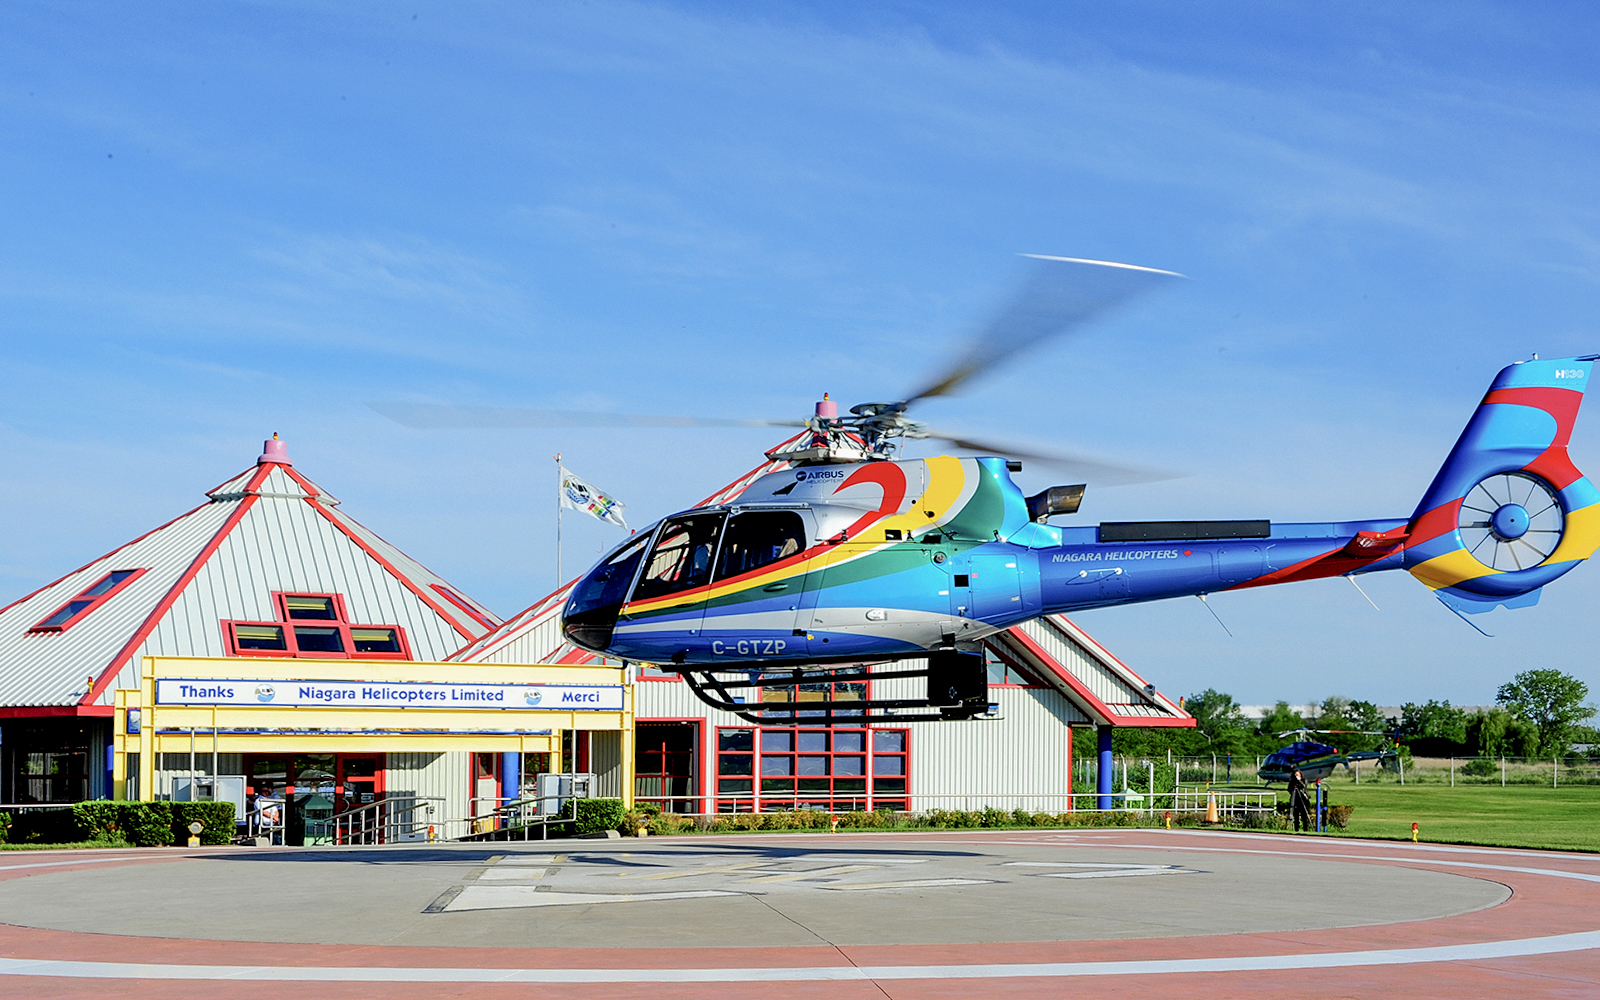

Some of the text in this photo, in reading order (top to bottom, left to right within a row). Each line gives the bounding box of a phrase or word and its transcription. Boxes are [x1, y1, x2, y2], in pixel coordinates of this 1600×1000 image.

[1555, 369, 1585, 379] H130
[807, 470, 844, 480] AIRBUS
[1052, 549, 1178, 562] NIAGARA HELICOPTERS
[712, 640, 787, 655] C-GTZP
[179, 685, 235, 698] Thanks
[299, 686, 504, 702] Niagara Helicopters Limited
[561, 690, 600, 702] Merci
